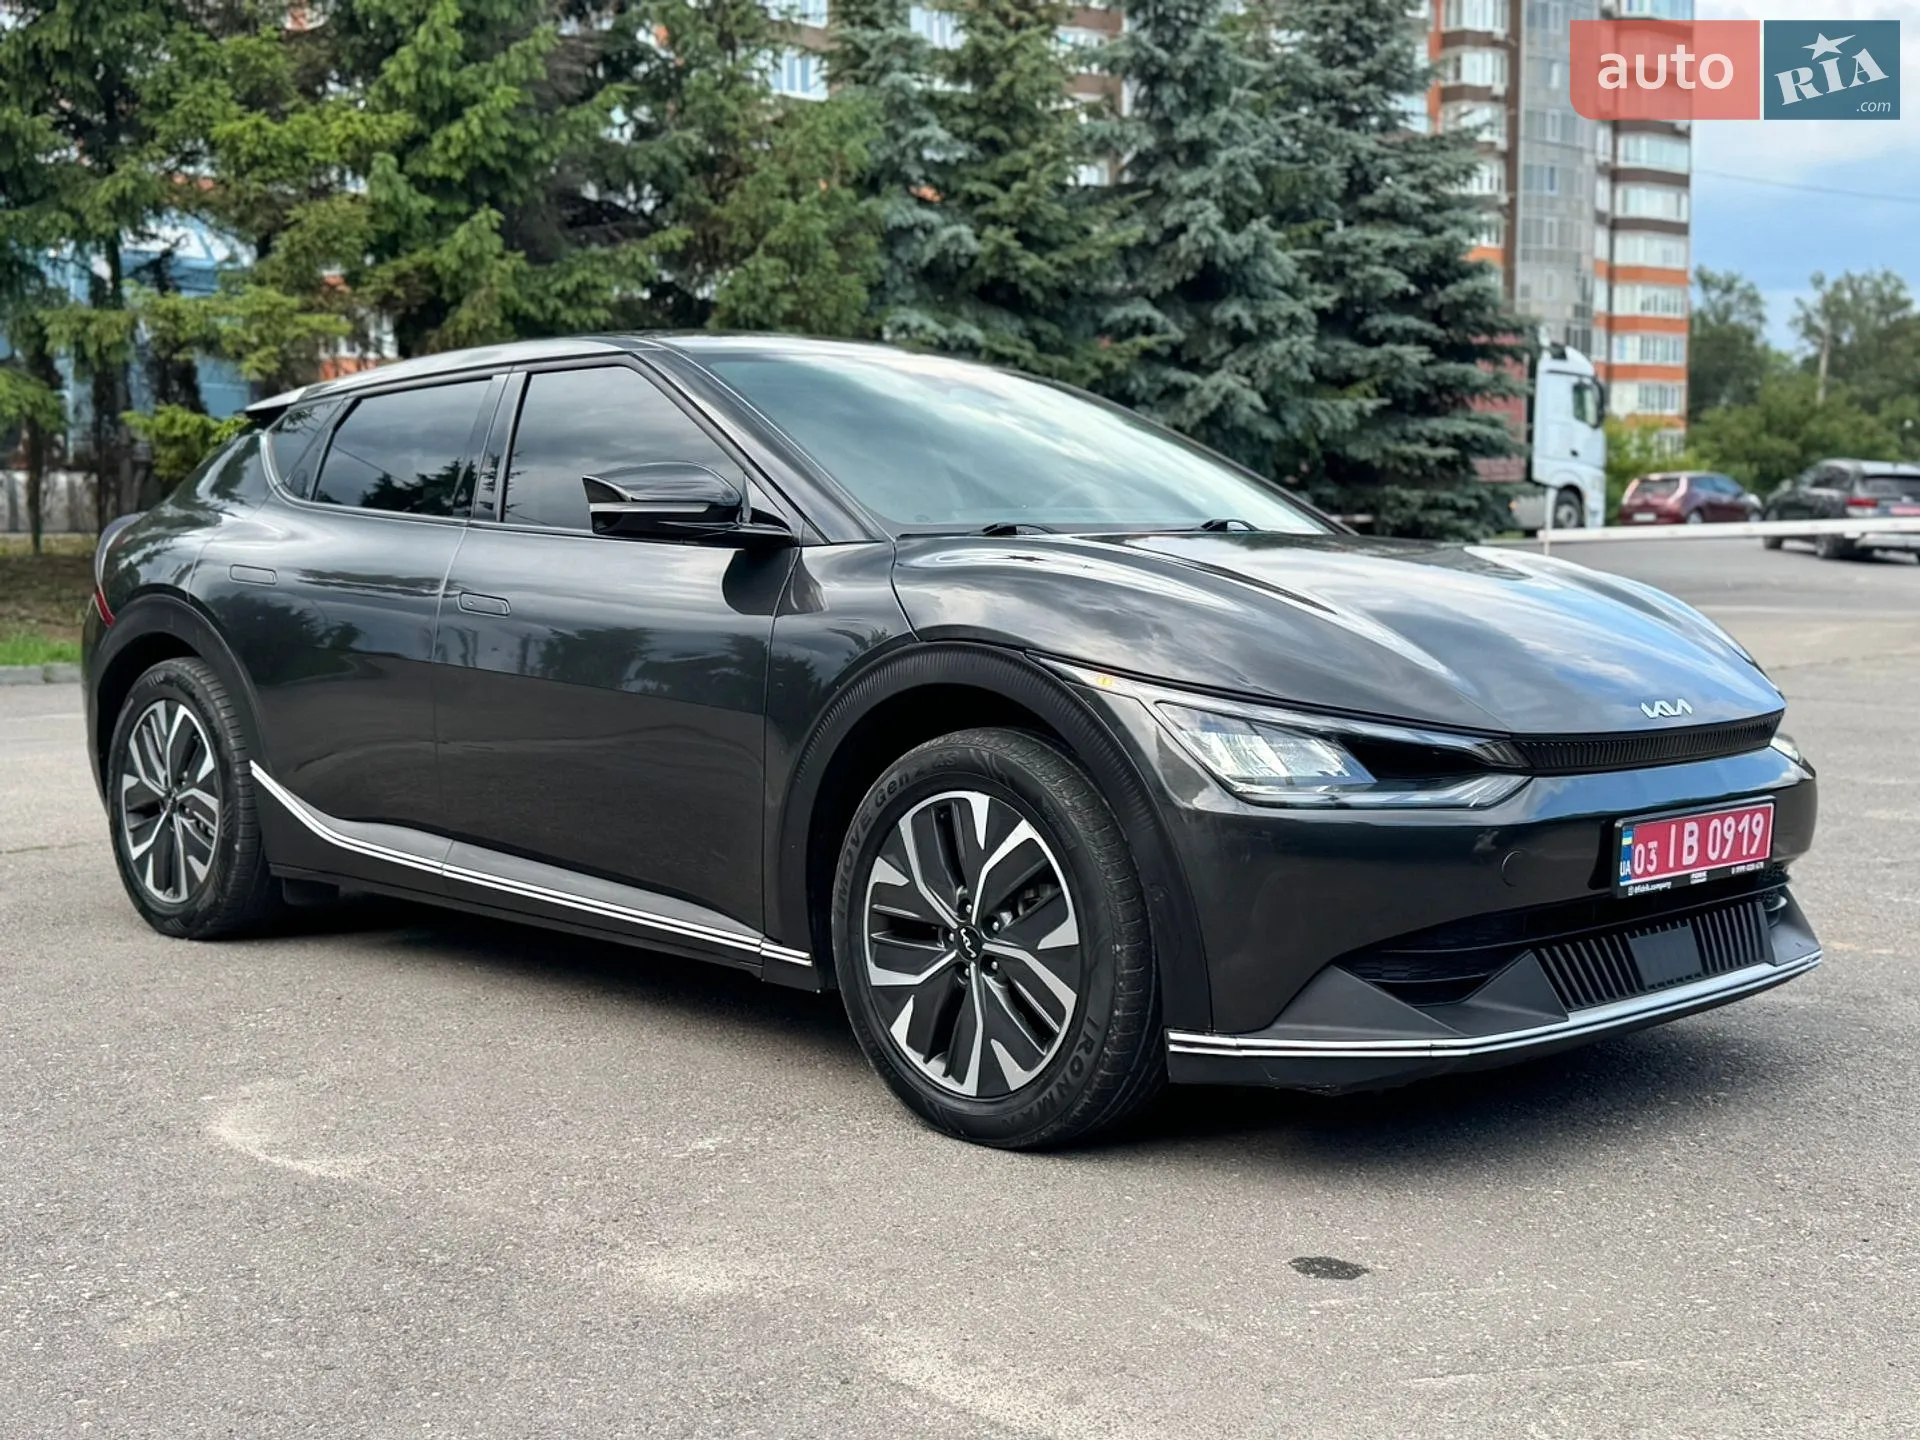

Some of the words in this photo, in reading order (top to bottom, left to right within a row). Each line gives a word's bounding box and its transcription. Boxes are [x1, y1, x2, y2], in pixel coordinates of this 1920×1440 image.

[1634, 841, 1658, 875] 03
[1707, 812, 1764, 861] 0919
[1619, 860, 1631, 877] UA
